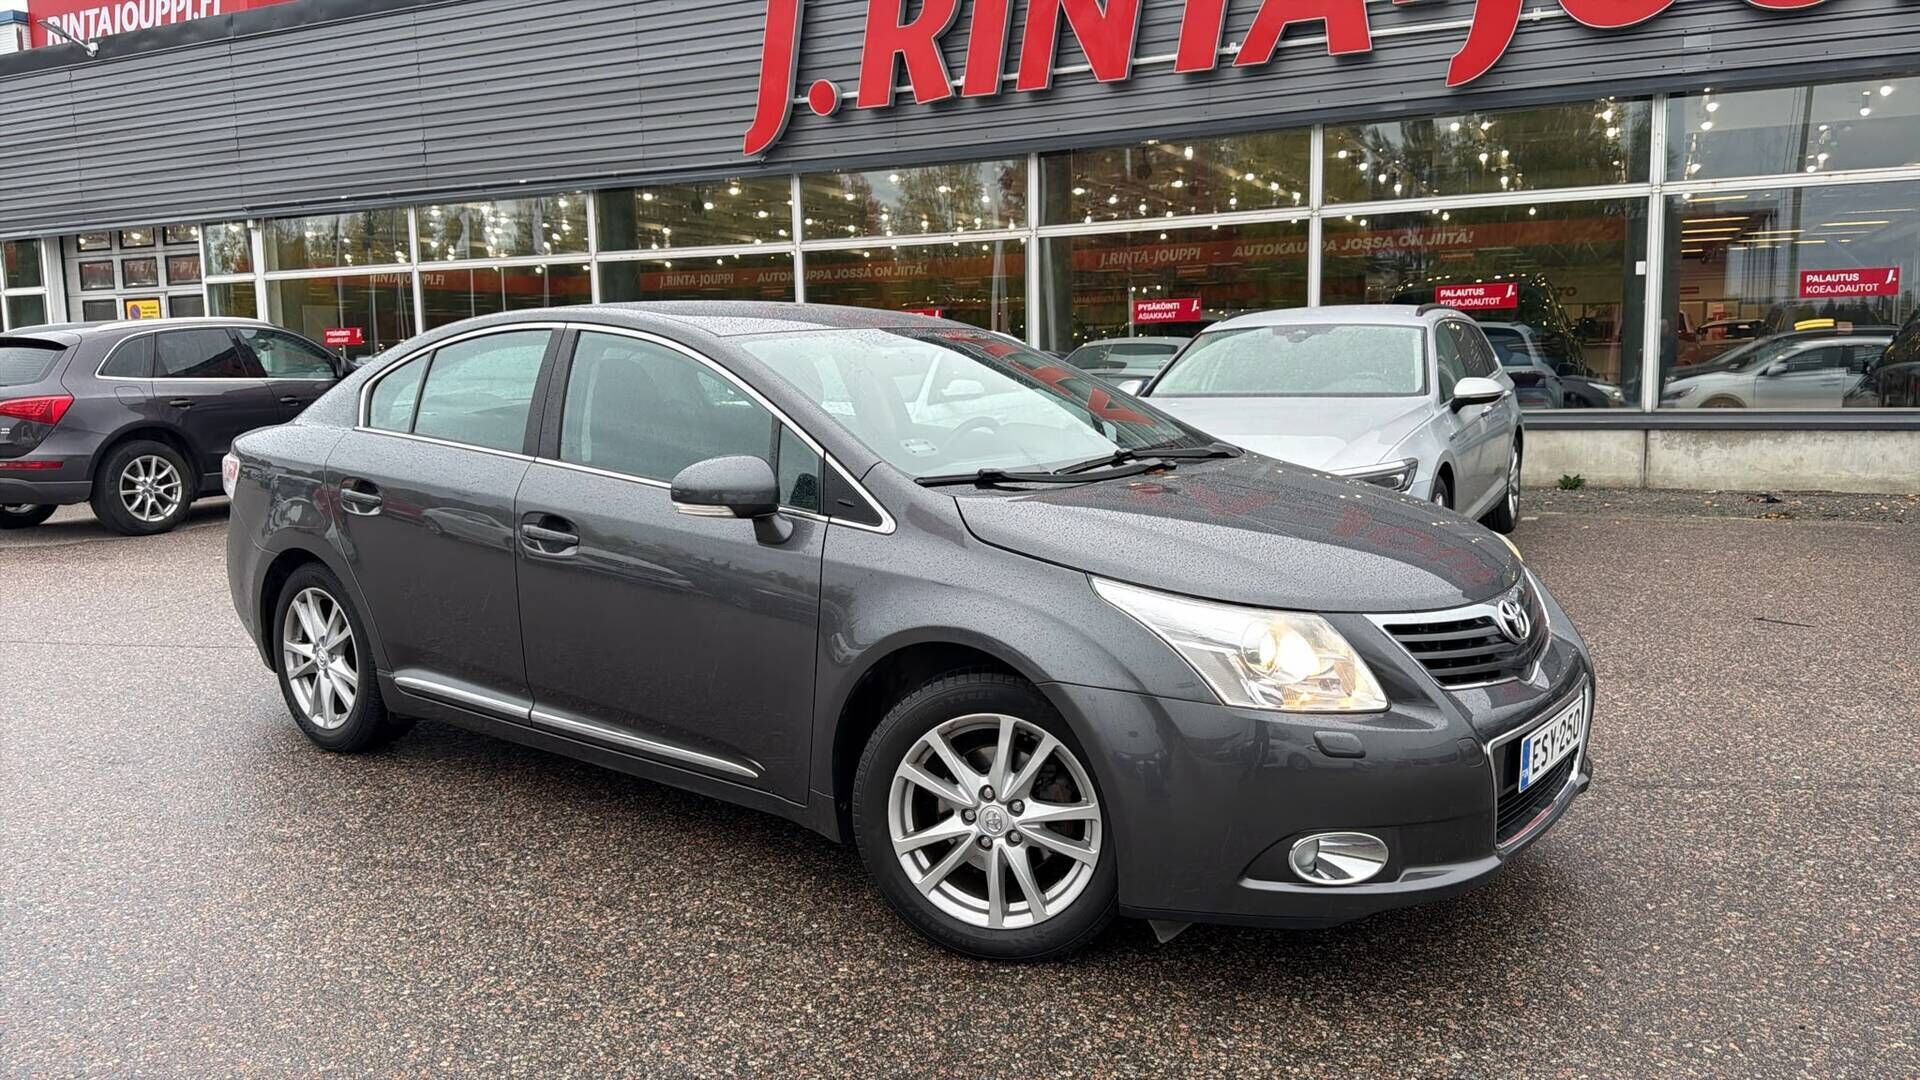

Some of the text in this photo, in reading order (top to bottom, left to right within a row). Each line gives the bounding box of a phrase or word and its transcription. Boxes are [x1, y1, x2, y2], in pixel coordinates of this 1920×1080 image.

[1100, 248, 1200, 268] J.RINTA-JOUPPI
[1232, 239, 1337, 257] AUTOKAUPA
[1342, 236, 1394, 250] JOSSA
[1399, 234, 1424, 247] ON
[1426, 228, 1474, 246] JIITÄ!
[660, 273, 734, 288] J.RINTA-JOUPPI
[757, 269, 832, 283] AUTOKUPPA
[834, 267, 872, 279] JOSSA
[874, 266, 892, 277] ON
[1806, 273, 1860, 282] PALAUTUS
[1440, 288, 1485, 297] PALAUTUS
[1806, 283, 1879, 293] KOEAJOAUTOT
[1138, 302, 1180, 310] PYSÄKÖINTI
[1440, 297, 1502, 306] KOEAJOAUTOT
[1138, 312, 1176, 320] ASIAKKAAT
[1532, 707, 1581, 775] ESY-250
